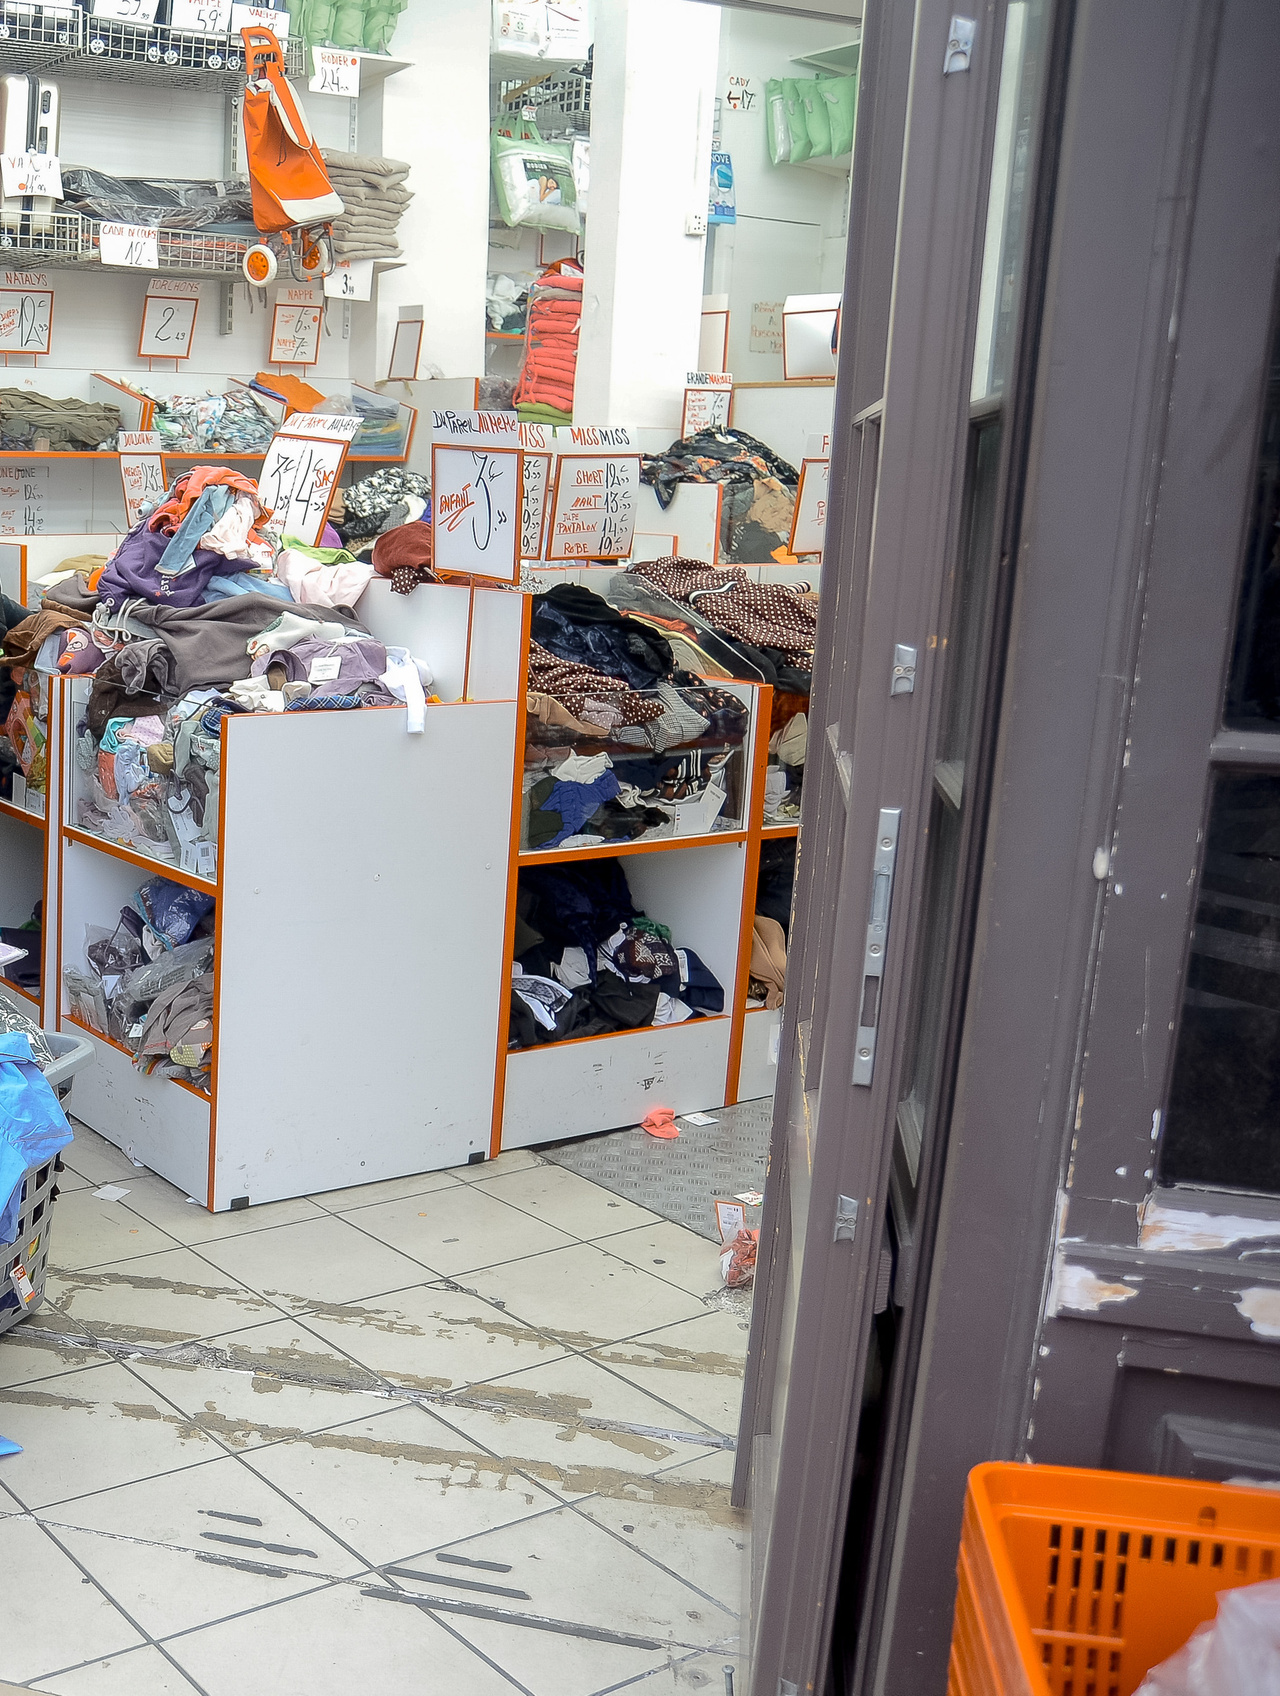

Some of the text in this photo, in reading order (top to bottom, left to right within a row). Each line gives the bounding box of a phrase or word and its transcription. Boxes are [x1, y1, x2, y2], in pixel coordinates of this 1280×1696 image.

[729, 76, 751, 88] CADY
[5, 271, 48, 287] NATALYS
[151, 279, 200, 293] TORCHONS
[287, 289, 313, 300] NAPPE
[570, 427, 631, 446] MISS MISS
[314, 469, 335, 489] SAC
[576, 469, 604, 485] SHORT
[556, 521, 599, 535] PANTALON
[564, 542, 589, 555] ROBE
